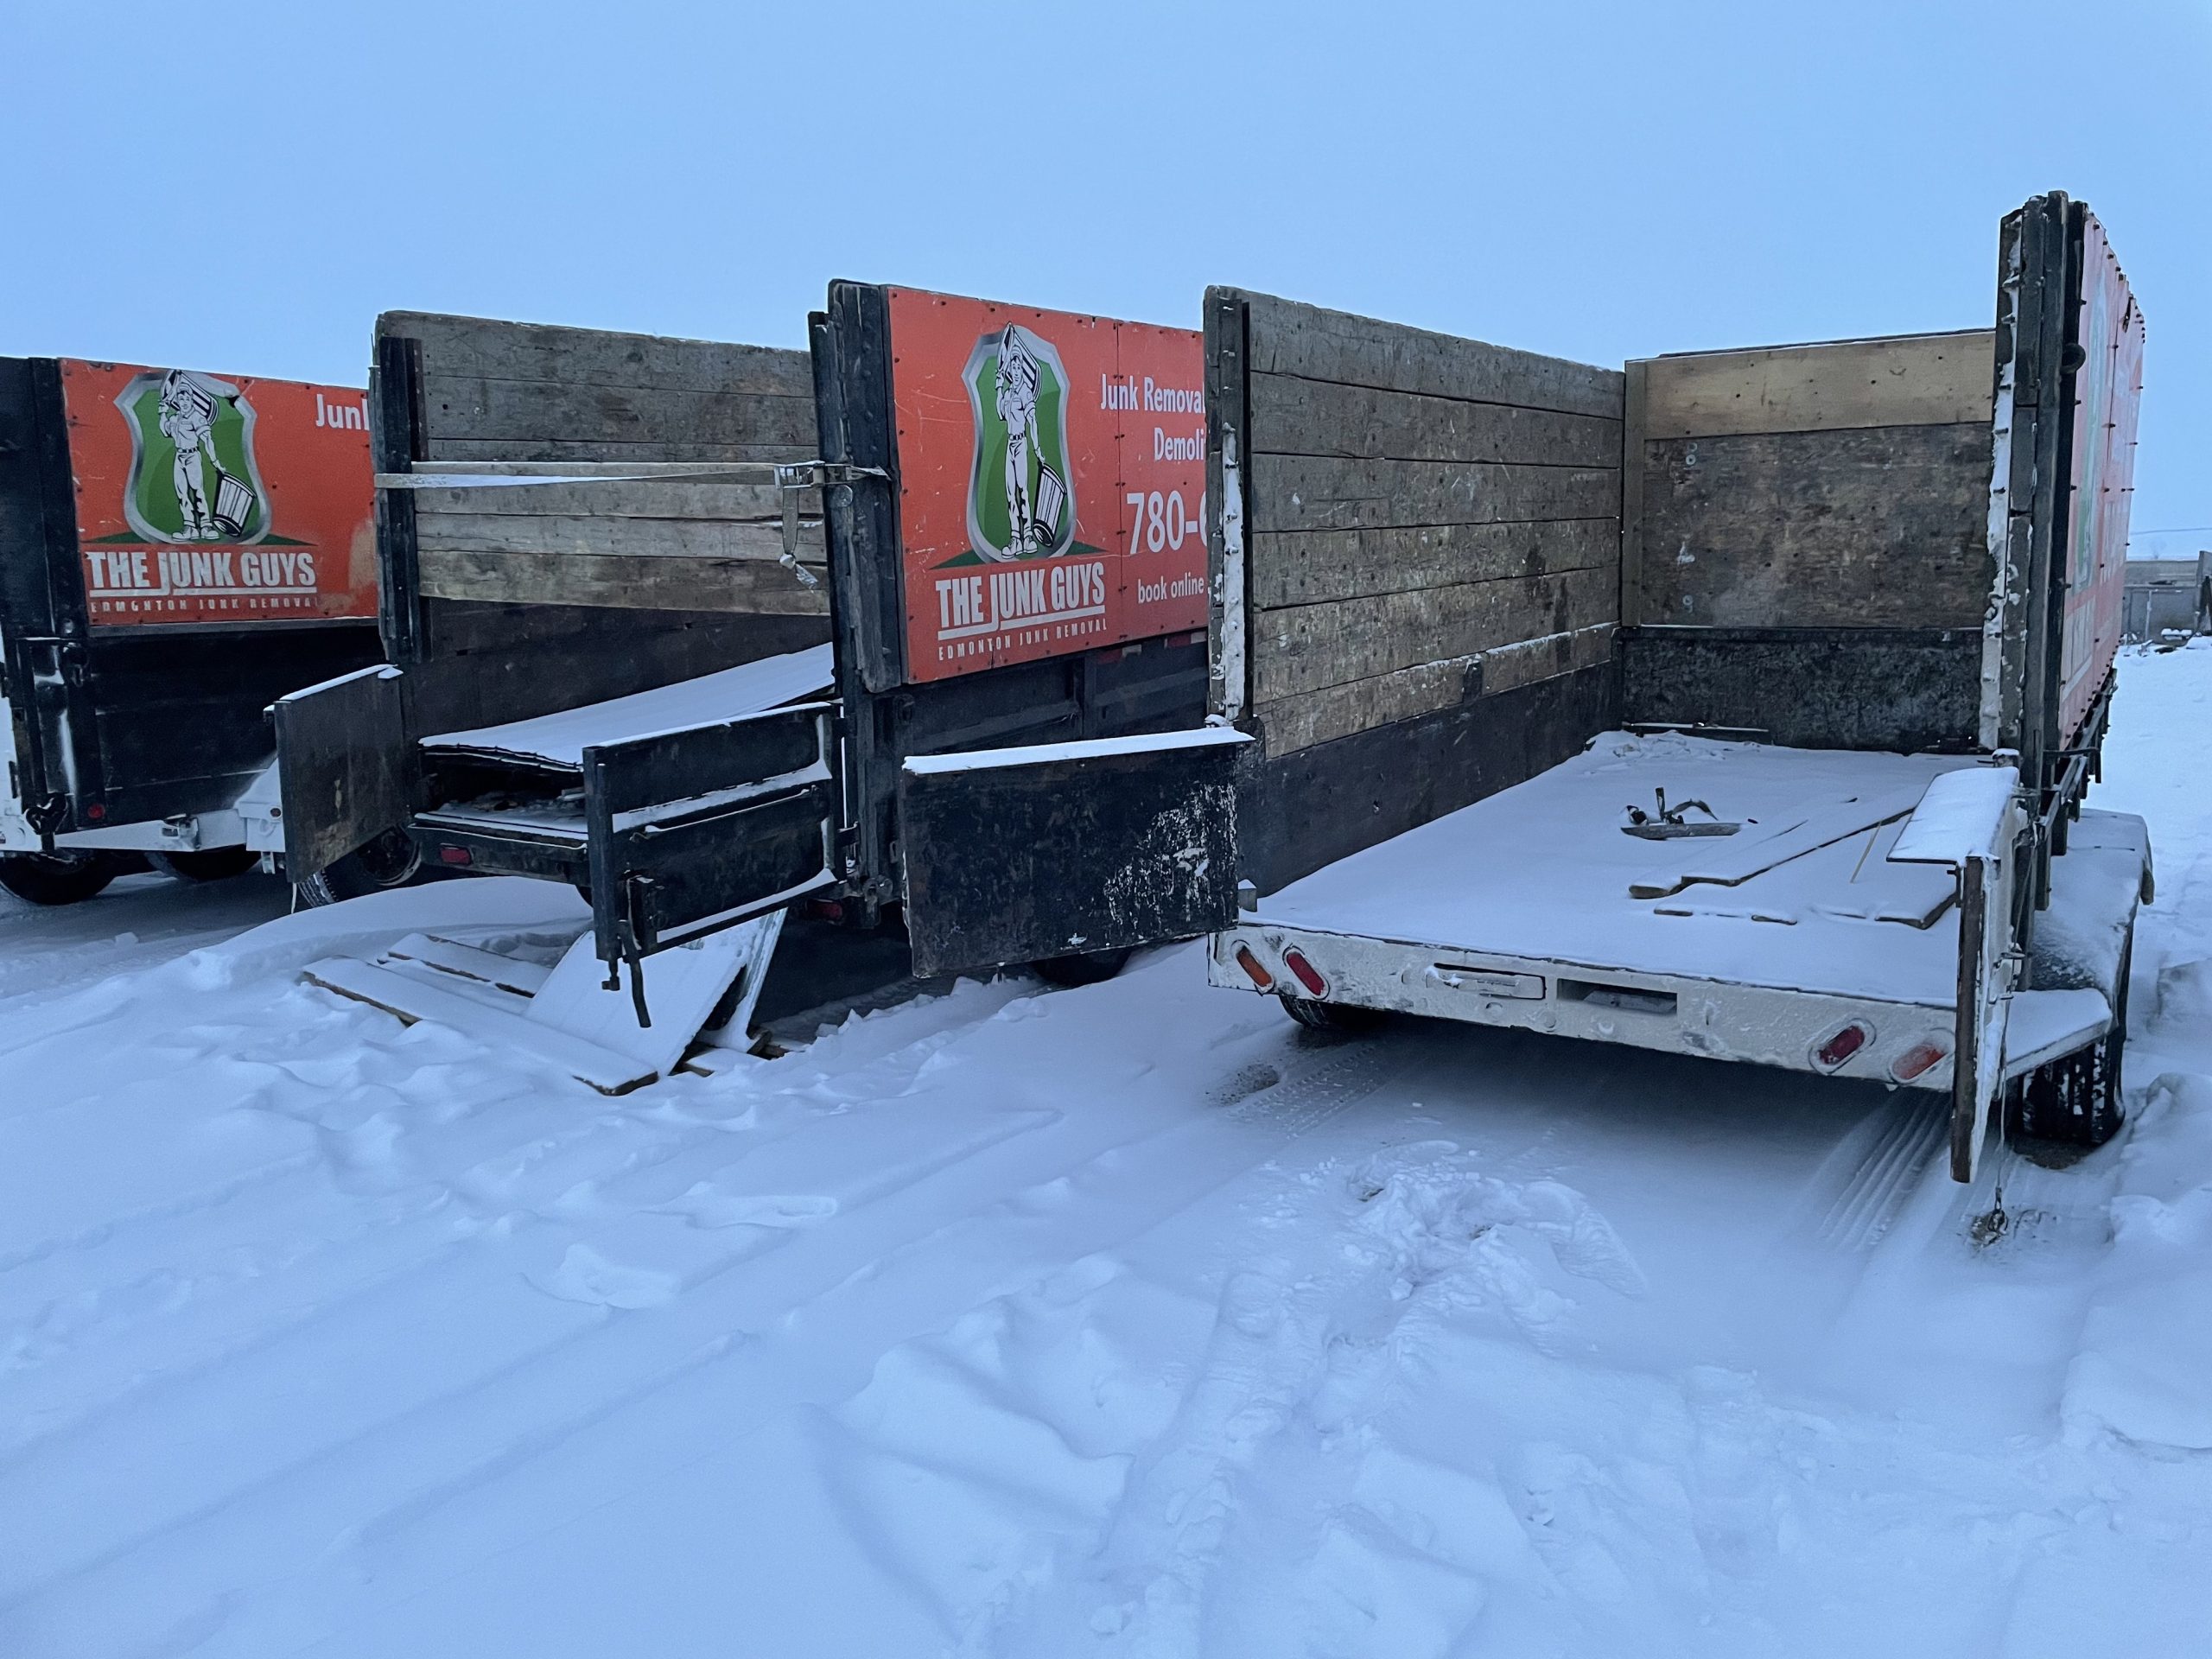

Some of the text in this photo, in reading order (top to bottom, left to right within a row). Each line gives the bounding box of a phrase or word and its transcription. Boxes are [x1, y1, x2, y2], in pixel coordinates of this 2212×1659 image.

[1100, 373, 1139, 410] Junk
[1154, 427, 1206, 461] Demoli
[86, 551, 316, 595] THE JUNK GUYS
[1137, 571, 1205, 604] book online
[199, 598, 239, 610] JUNK
[935, 562, 1105, 631] THE JUNK GUYS
[938, 618, 1107, 661] EDMONTON JUNK REMOVAL
